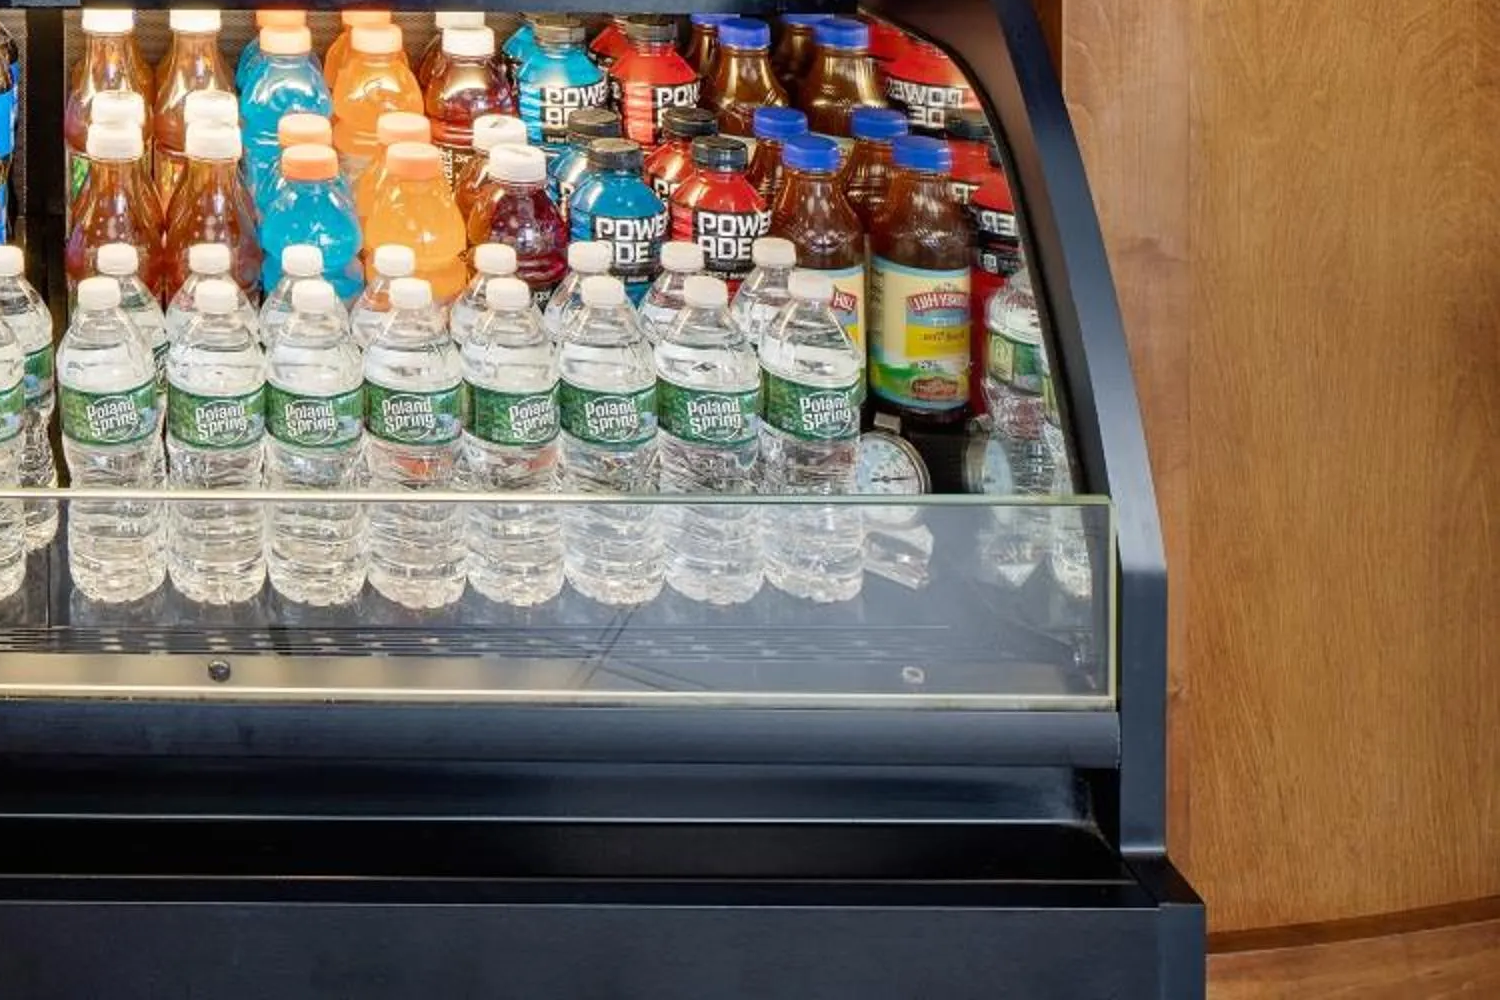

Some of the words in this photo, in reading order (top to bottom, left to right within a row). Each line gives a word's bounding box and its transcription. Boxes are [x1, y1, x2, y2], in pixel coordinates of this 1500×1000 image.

[616, 242, 649, 264] DE
[697, 236, 752, 260] ADE
[87, 397, 135, 421] Poland
[196, 404, 245, 424] Poland
[285, 400, 333, 422] Poland
[383, 395, 432, 418] Poland
[584, 399, 636, 421] Poland
[687, 397, 740, 420] Poland
[800, 393, 849, 418] Poland
[91, 413, 139, 437] Spring
[198, 418, 248, 440] Spring
[288, 416, 336, 439] Spring
[384, 413, 435, 436] Spring
[587, 413, 639, 438] Spring
[690, 413, 742, 437] Spring
[803, 408, 852, 433] Spring
